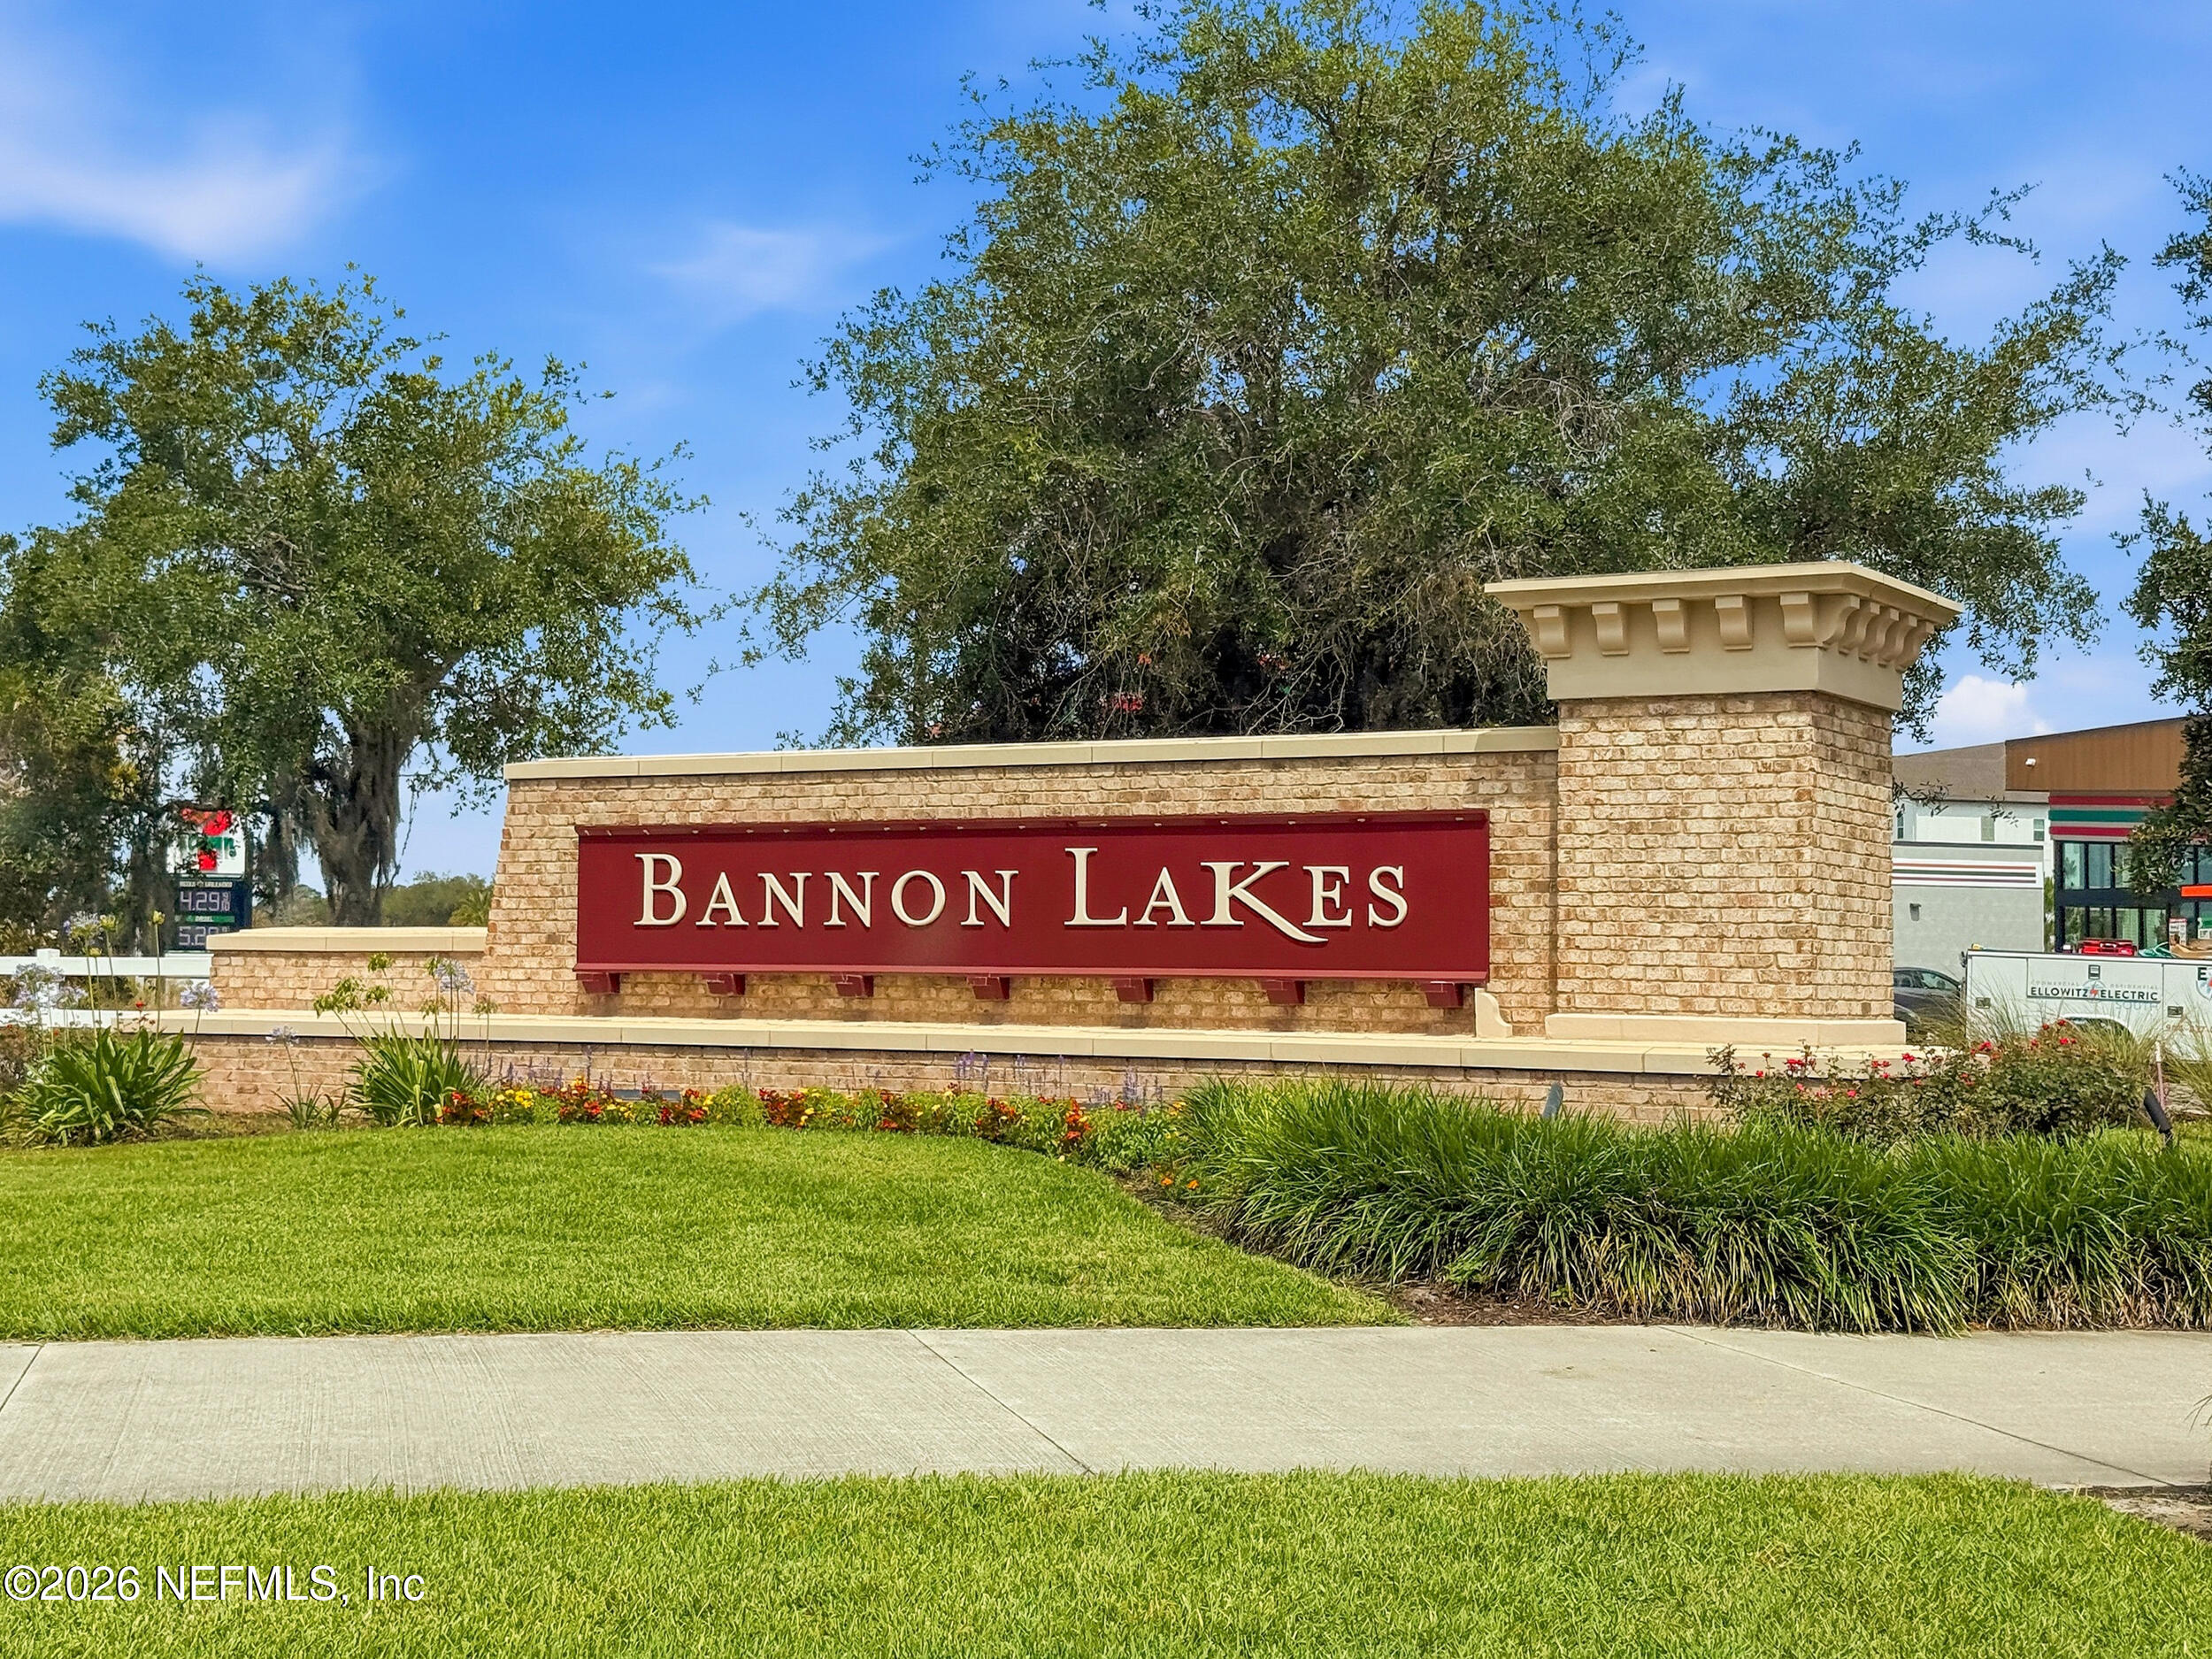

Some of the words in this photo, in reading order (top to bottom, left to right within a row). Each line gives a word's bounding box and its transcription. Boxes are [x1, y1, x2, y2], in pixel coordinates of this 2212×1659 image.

[633, 850, 1020, 929] BANNON
[1064, 845, 1410, 944] LAKES
[2031, 987, 2088, 997] ELLOWITZ
[2101, 989, 2158, 1001] ELECTRIC
